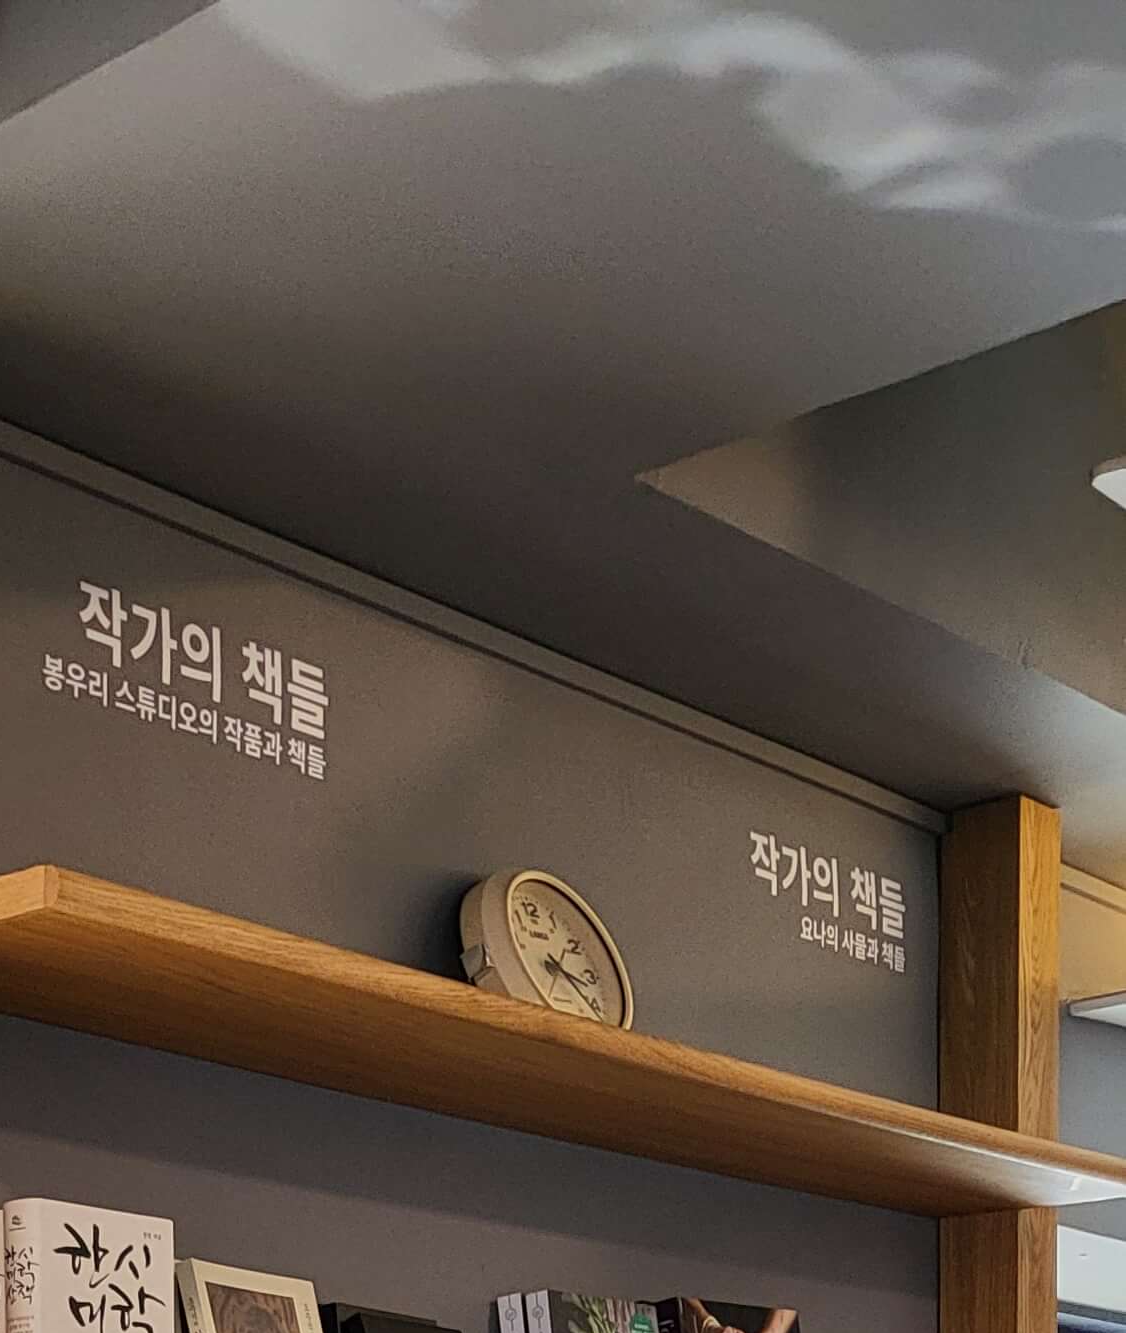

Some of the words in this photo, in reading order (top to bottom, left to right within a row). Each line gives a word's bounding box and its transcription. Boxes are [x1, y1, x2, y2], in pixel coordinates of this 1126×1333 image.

[79, 580, 222, 704] 작가의
[241, 640, 330, 740] 책들
[42, 653, 110, 707] 봉우리
[114, 680, 219, 745] 스튜디오의
[223, 715, 283, 766] 작품과
[287, 736, 327, 781] 책들
[521, 899, 541, 919] 12
[749, 831, 840, 918] 작가의
[850, 866, 907, 940] 책들
[566, 938, 583, 956] 2
[800, 916, 839, 953] 요나의
[842, 929, 880, 965] 사물과
[882, 941, 906, 973] 책들
[53, 1223, 152, 1289] 한시
